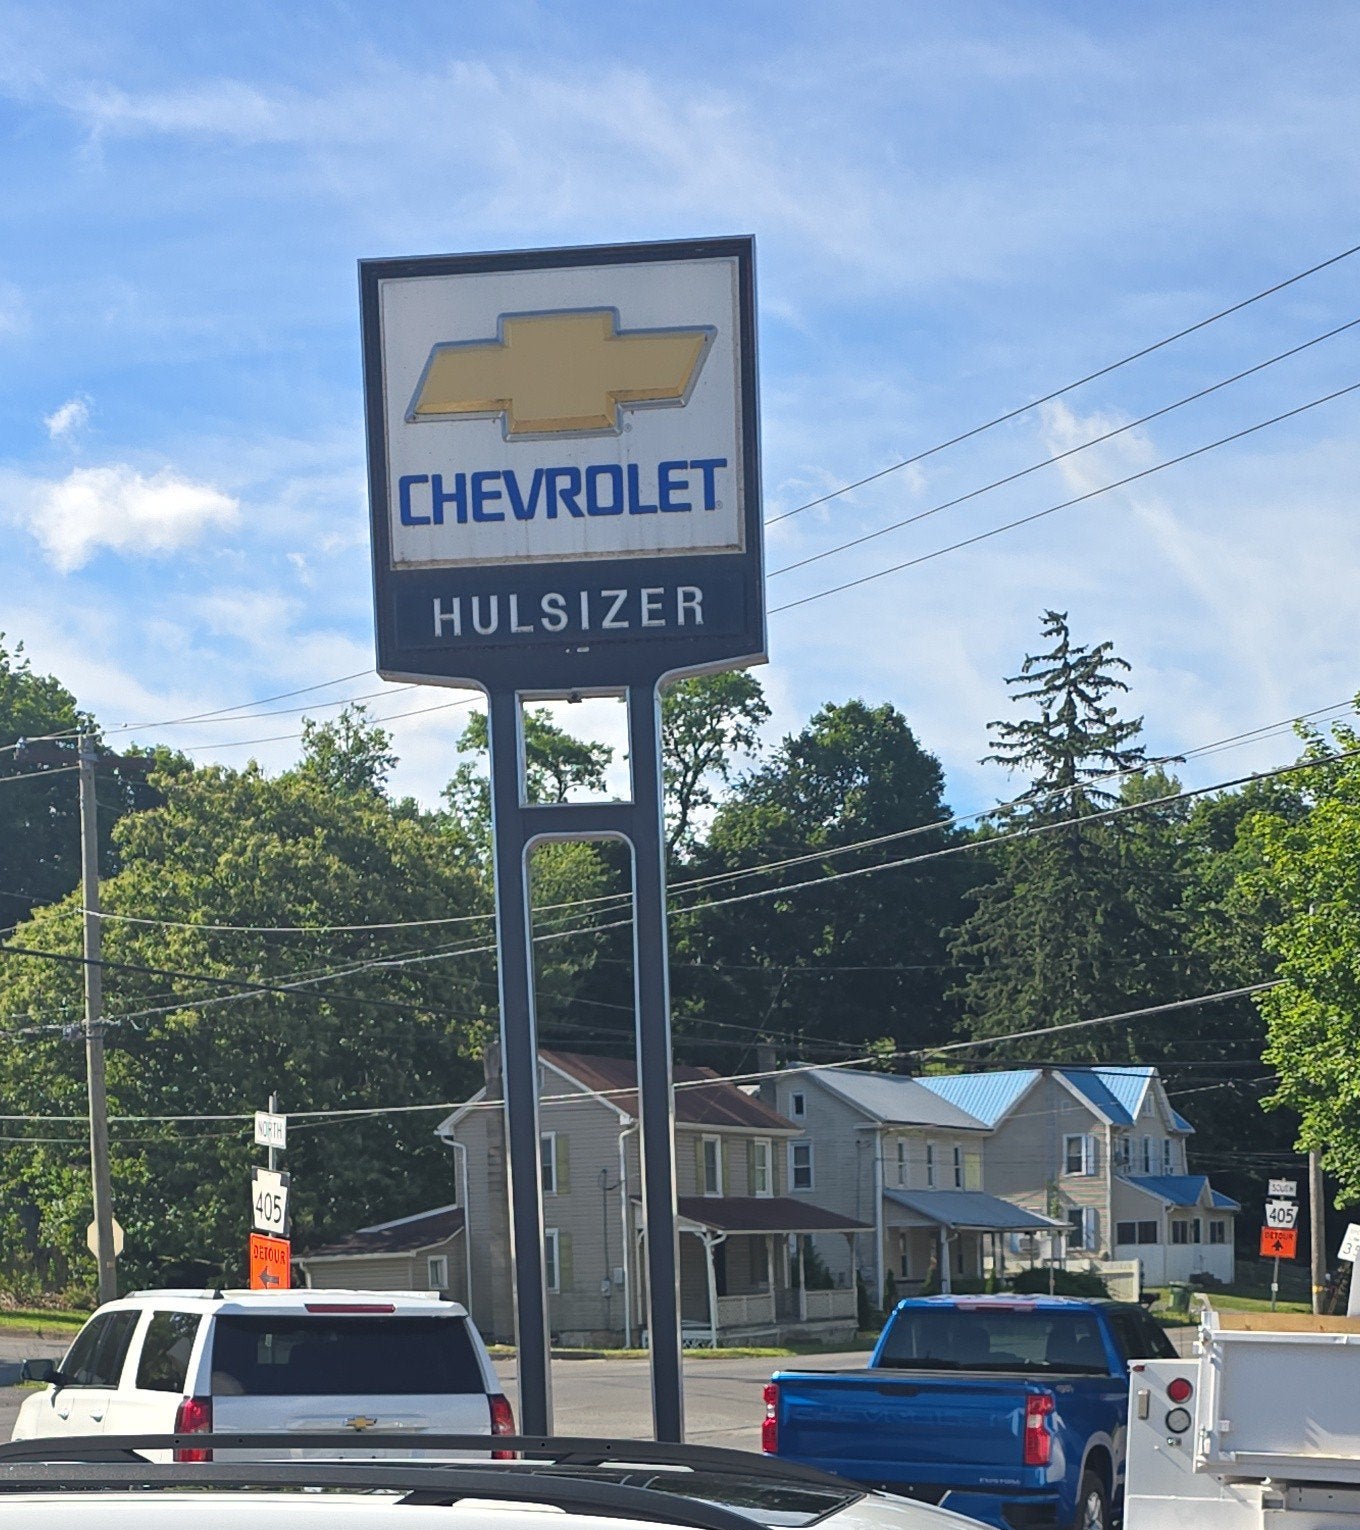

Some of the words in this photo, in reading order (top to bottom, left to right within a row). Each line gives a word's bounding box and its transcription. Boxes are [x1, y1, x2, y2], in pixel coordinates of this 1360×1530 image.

[398, 458, 728, 526] CHEVROLET
[432, 585, 705, 637] HULSIZER
[257, 1121, 283, 1140] NORTH
[1271, 1183, 1294, 1193] SOUTH
[255, 1190, 282, 1224] 405
[1269, 1208, 1294, 1224] 405
[1264, 1231, 1294, 1241] DETOUR
[253, 1244, 286, 1266] DETOUR
